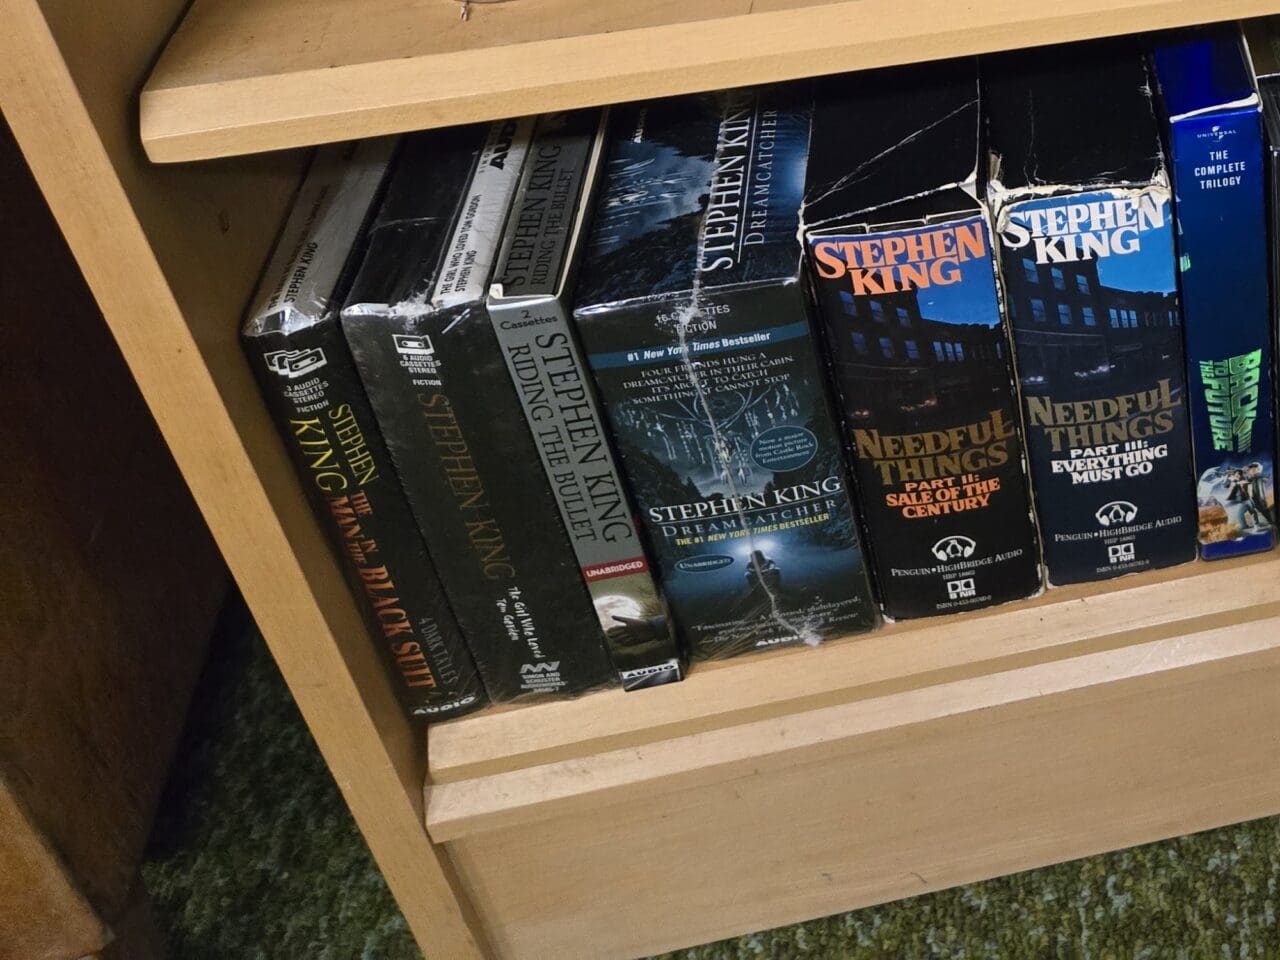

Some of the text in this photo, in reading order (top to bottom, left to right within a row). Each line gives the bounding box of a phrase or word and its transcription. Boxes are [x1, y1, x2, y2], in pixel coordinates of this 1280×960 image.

[1194, 161, 1247, 177] COMPLETE
[1208, 149, 1229, 161] THE
[743, 109, 778, 247] DREAMCATCHER
[1199, 175, 1242, 190] TRILOGY
[500, 144, 563, 288] STEPHEN KING
[530, 167, 575, 286] RIDING THE BULLET
[1000, 192, 1170, 249] STEPHEN
[813, 221, 987, 280] STEPHEN
[1032, 226, 1141, 265] KING
[848, 255, 963, 296] KING
[499, 313, 559, 331] Cassettes
[520, 309, 531, 320] 2
[627, 351, 640, 362] #1
[643, 349, 665, 361] New
[692, 340, 722, 353] Times
[721, 332, 772, 348] Bestseller
[399, 360, 442, 368] CASSETTES
[407, 366, 438, 374] STEREO
[292, 390, 325, 404] STEREO
[412, 378, 443, 387] FICTION
[296, 399, 330, 414] FICTION
[1025, 377, 1182, 427] NEEDFUL
[1202, 378, 1234, 452] FUTURE
[328, 403, 380, 487] STEPHEN
[506, 342, 598, 542] RIDING THE BULLET
[534, 331, 634, 544] STEPHEN KING
[851, 408, 1017, 461] NEEDFUL
[1044, 409, 1175, 453] THINGS
[288, 416, 349, 491] KING
[873, 439, 1010, 486] THINGS
[1050, 444, 1169, 474] EVERYTHING
[1069, 439, 1149, 459] PART III:
[416, 392, 516, 581] STEPHEN KING
[904, 473, 981, 492] PART II:
[1070, 461, 1154, 485] MUST GO
[649, 476, 843, 524] STEPHEN KING
[885, 476, 1002, 507] SALE OF THE
[901, 493, 993, 520] CENTURY
[660, 499, 839, 538] DREAMCATCHER
[675, 536, 695, 546] THE
[706, 532, 728, 543] NEW
[728, 528, 751, 541] YORK
[752, 523, 779, 536] TIMES
[778, 513, 831, 531] BESTSELLER
[586, 559, 644, 578] UNABRIDGED
[626, 664, 675, 679] AUDIO
[412, 695, 477, 716] AUDIO
